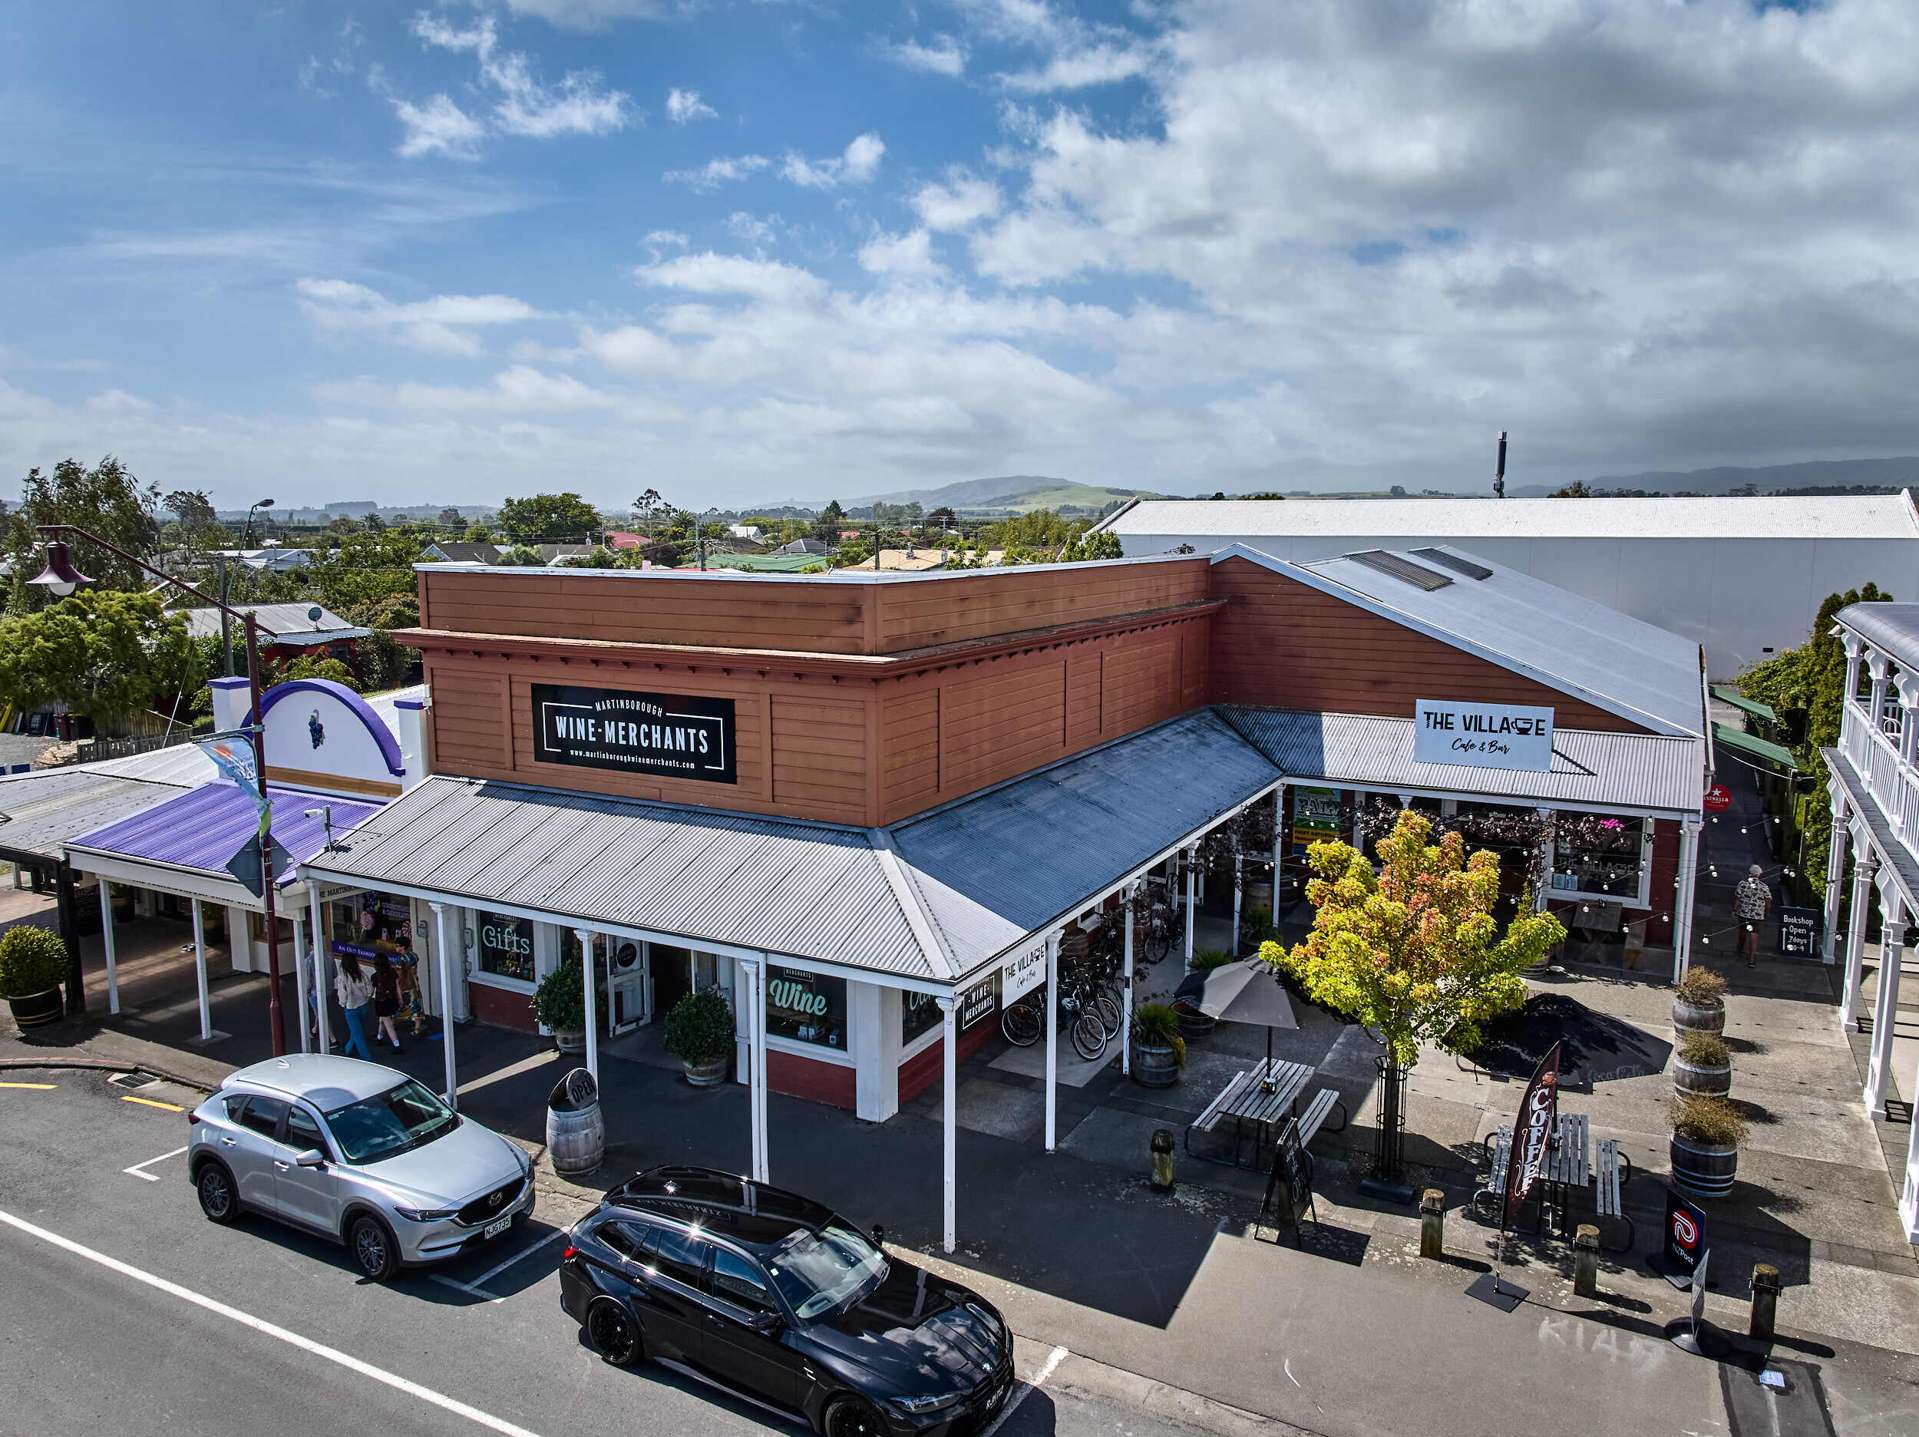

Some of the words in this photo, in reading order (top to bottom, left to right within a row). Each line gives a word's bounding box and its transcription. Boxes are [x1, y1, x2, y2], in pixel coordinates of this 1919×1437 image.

[595, 700, 663, 717] MARTINBOROUGH
[1423, 711, 1455, 731] THE
[1462, 714, 1546, 736] VILLAGE
[1451, 737, 1477, 753] Cafe
[1478, 742, 1486, 752] &
[1487, 739, 1510, 754] Bar
[570, 749, 695, 768] www.martinboroughwinemerchants.com
[1783, 914, 1814, 927] Bookshop
[1789, 925, 1807, 935] Open
[482, 925, 530, 955] Gifts
[1004, 962, 1016, 980] THE
[769, 979, 828, 1016] Wine
[965, 996, 993, 1022] MERCHANTS
[571, 1076, 597, 1104] OPEN
[1521, 1087, 1552, 1195] COFFEE
